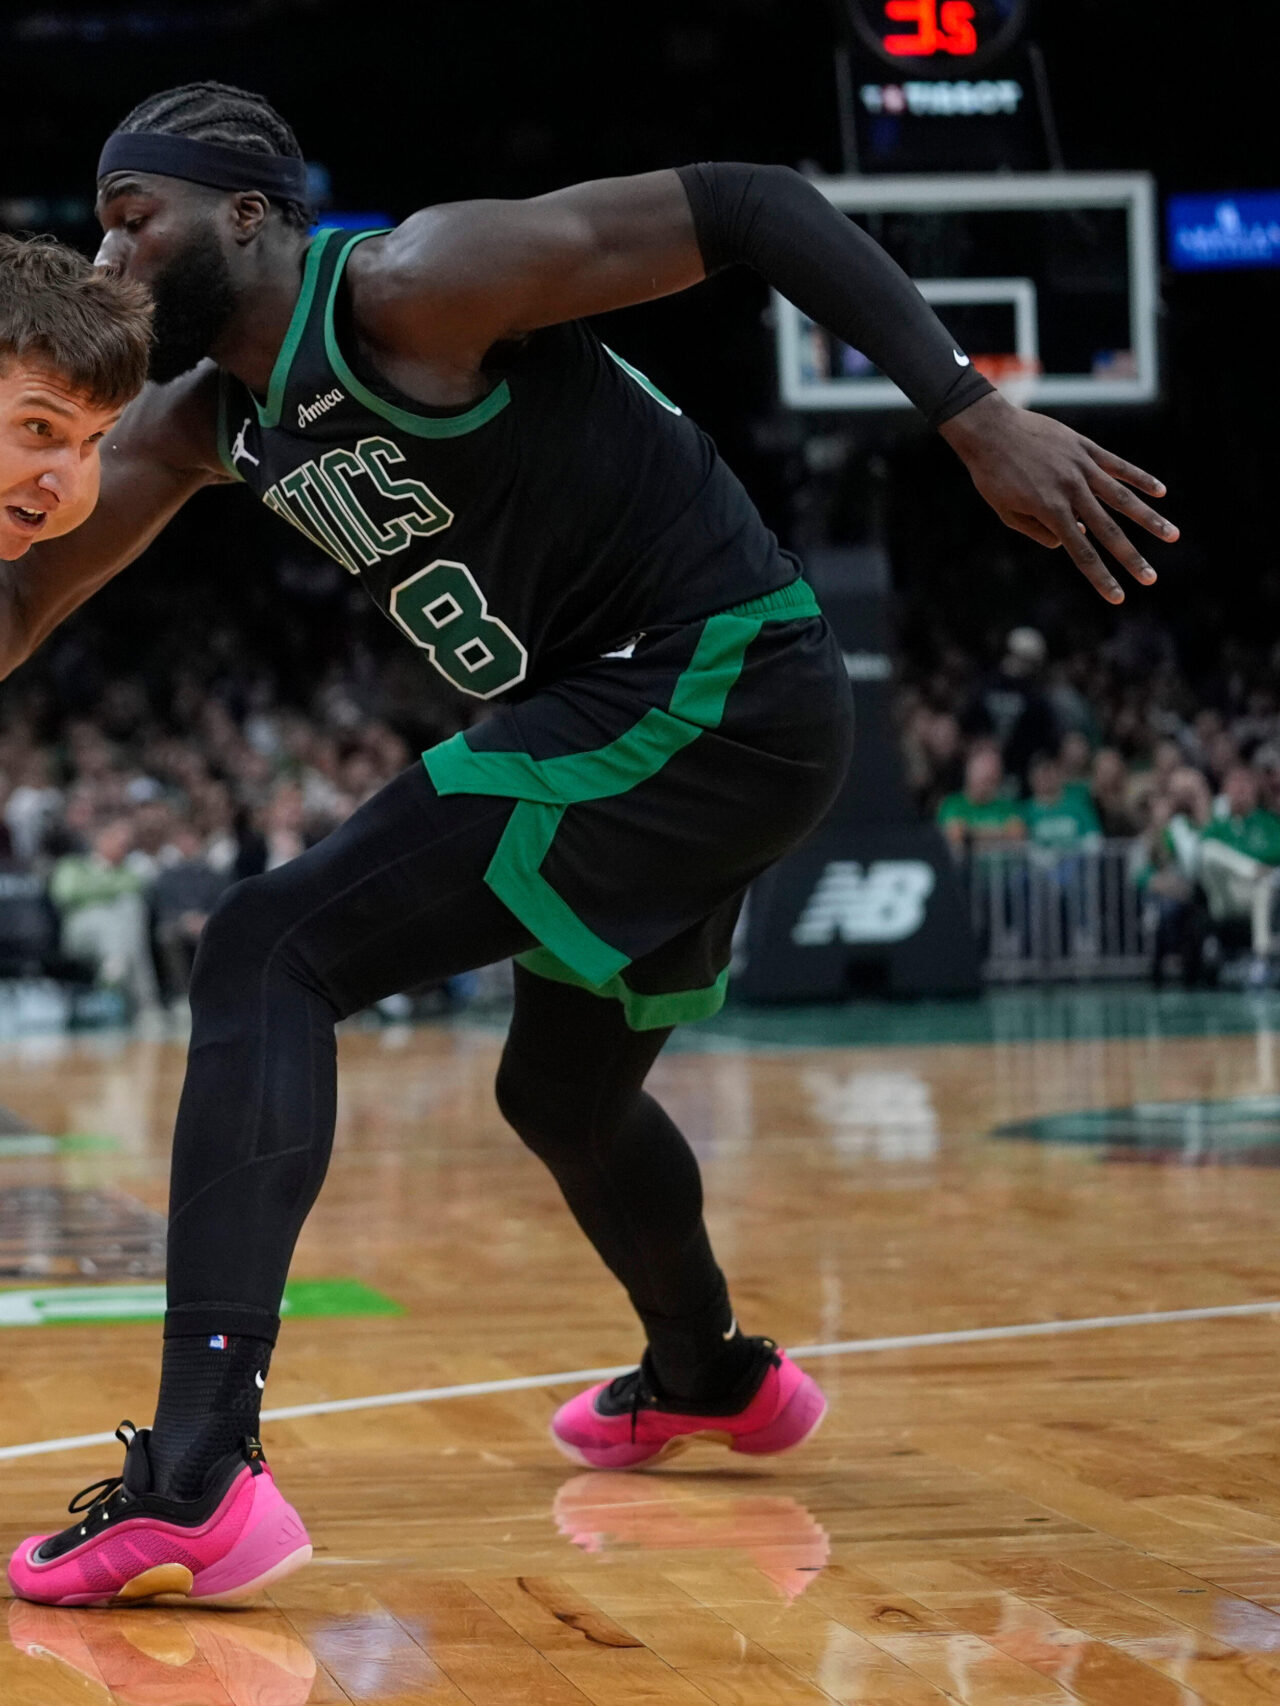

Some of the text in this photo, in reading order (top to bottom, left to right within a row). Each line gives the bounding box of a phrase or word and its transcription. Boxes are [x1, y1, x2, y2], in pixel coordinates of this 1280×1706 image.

[297, 388, 345, 428] Amica
[390, 559, 528, 699] 8
[790, 859, 936, 946] NB
